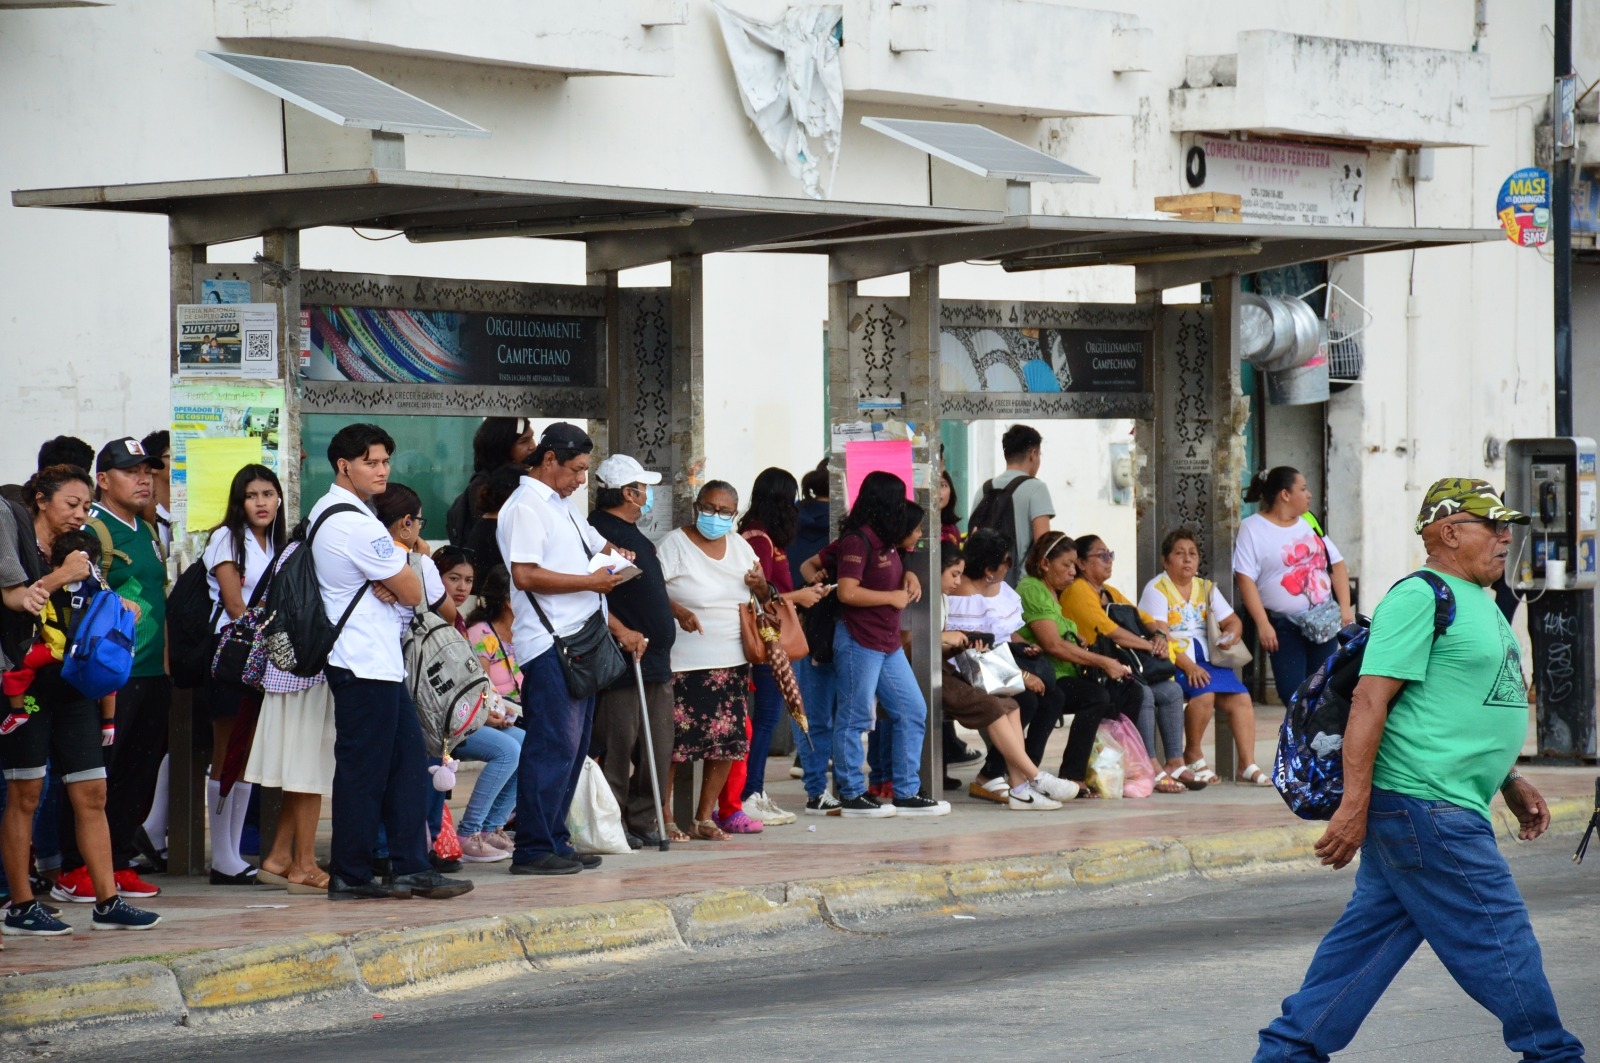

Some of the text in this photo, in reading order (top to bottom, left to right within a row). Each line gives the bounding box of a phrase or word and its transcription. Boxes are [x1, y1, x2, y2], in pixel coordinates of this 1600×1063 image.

[1204, 141, 1331, 169] COMERCIALIZADORA FERRETERA
[1512, 194, 1546, 204] DOMINGOS
[184, 324, 238, 334] JUVENTUD
[394, 391, 416, 401] CRECER
[421, 391, 445, 401] GRANDE
[186, 413, 220, 421] COSTURA
